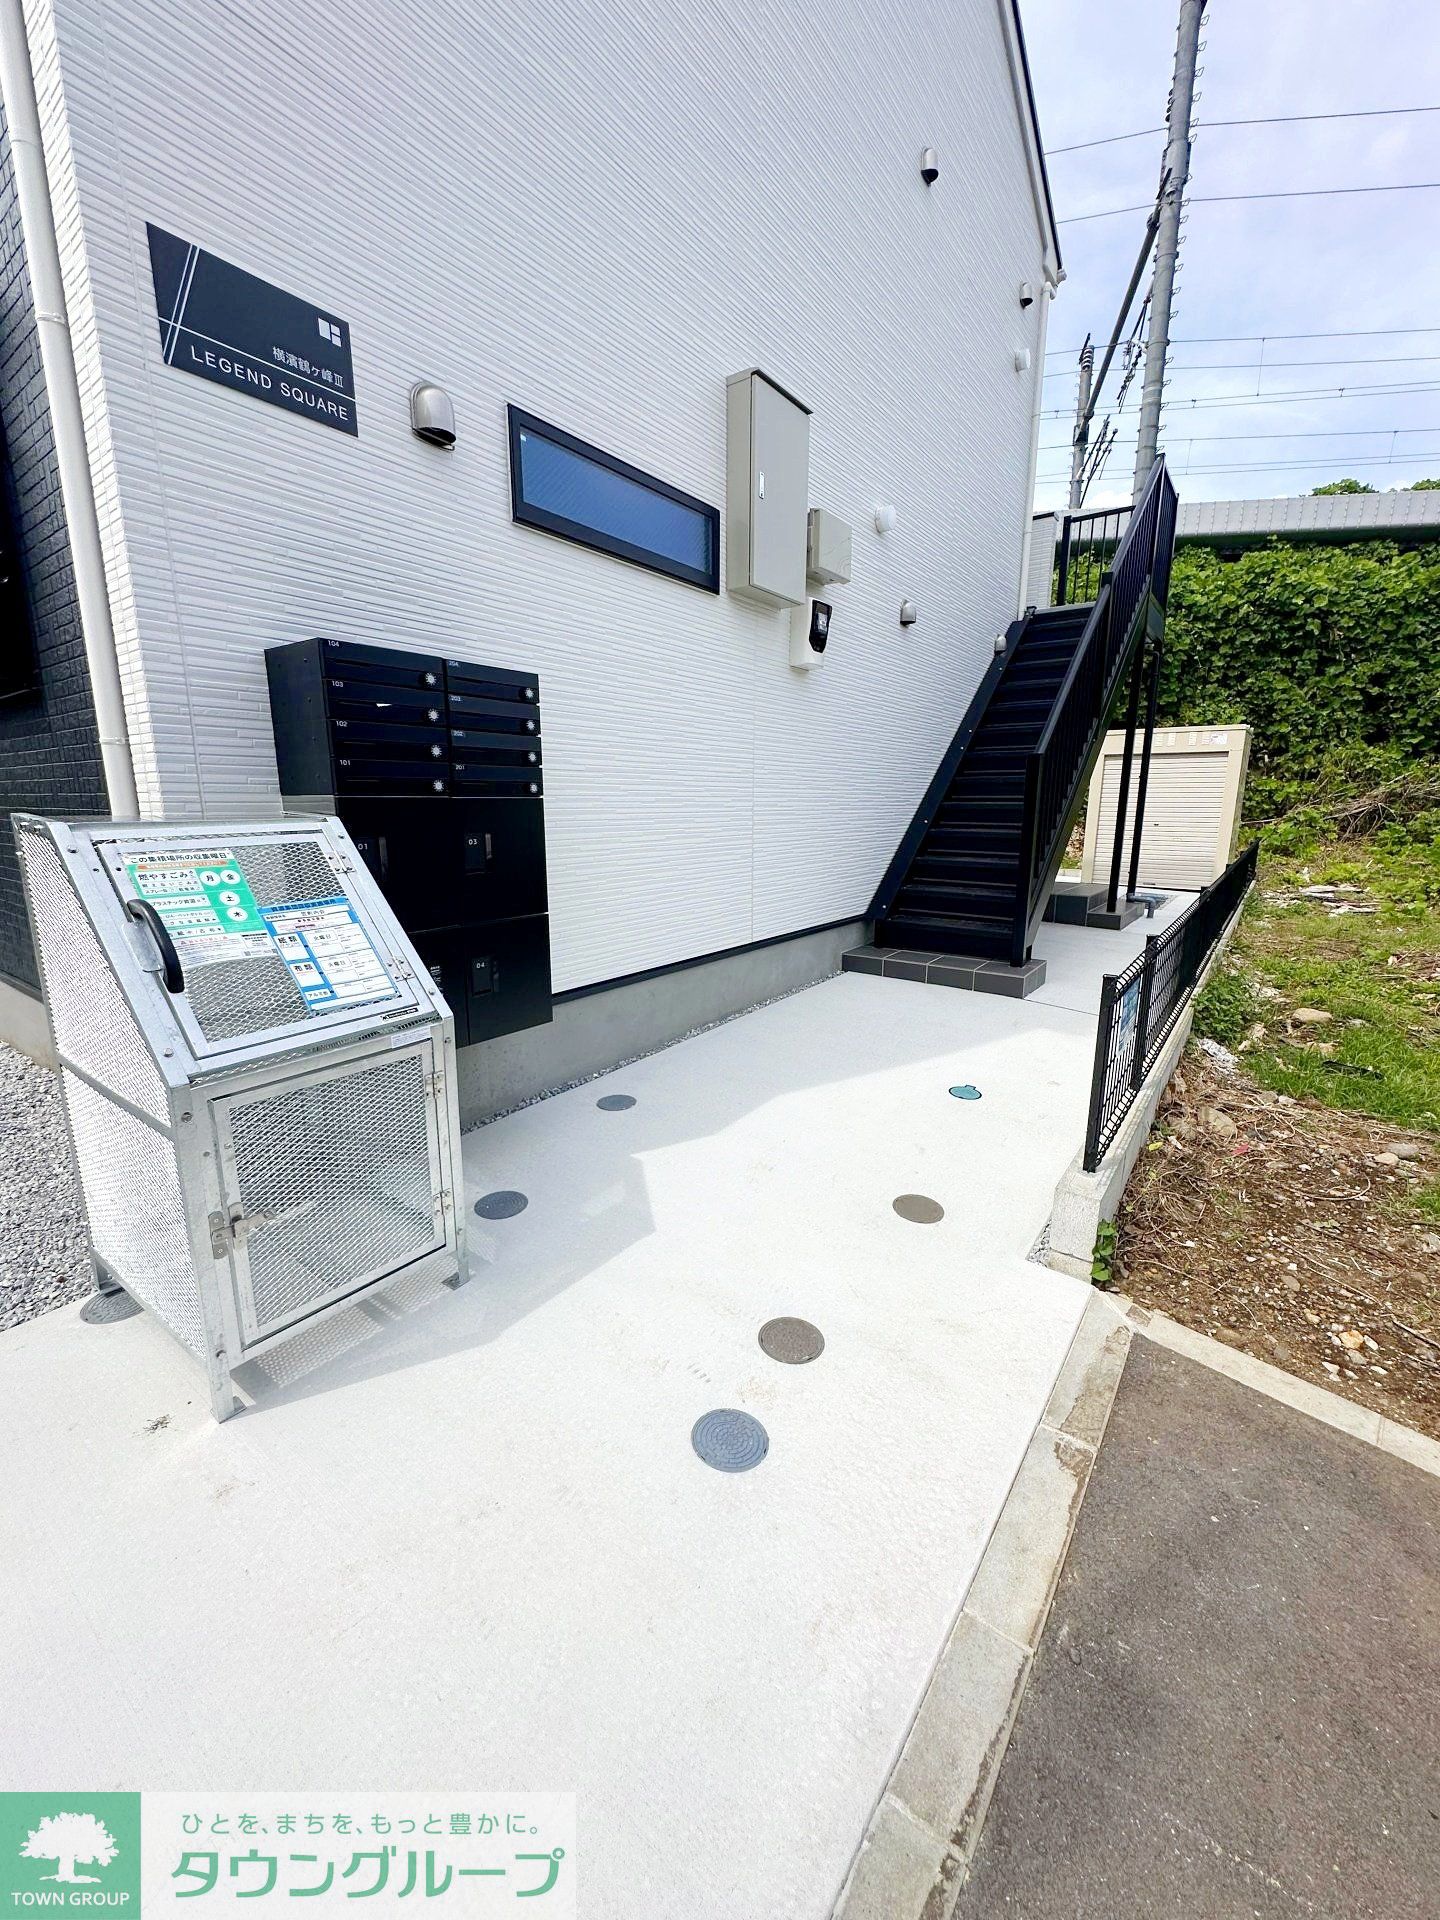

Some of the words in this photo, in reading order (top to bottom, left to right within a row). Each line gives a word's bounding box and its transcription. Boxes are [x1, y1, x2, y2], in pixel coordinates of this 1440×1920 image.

[191, 345, 272, 389] LEGEND
[279, 382, 350, 421] SQUARE
[327, 639, 340, 648] 104
[331, 680, 344, 688] 103
[335, 720, 348, 728] 102
[468, 838, 478, 846] 03
[130, 852, 227, 864] この集積場所の収集曜日
[225, 894, 235, 902] 土
[476, 961, 486, 969] 04
